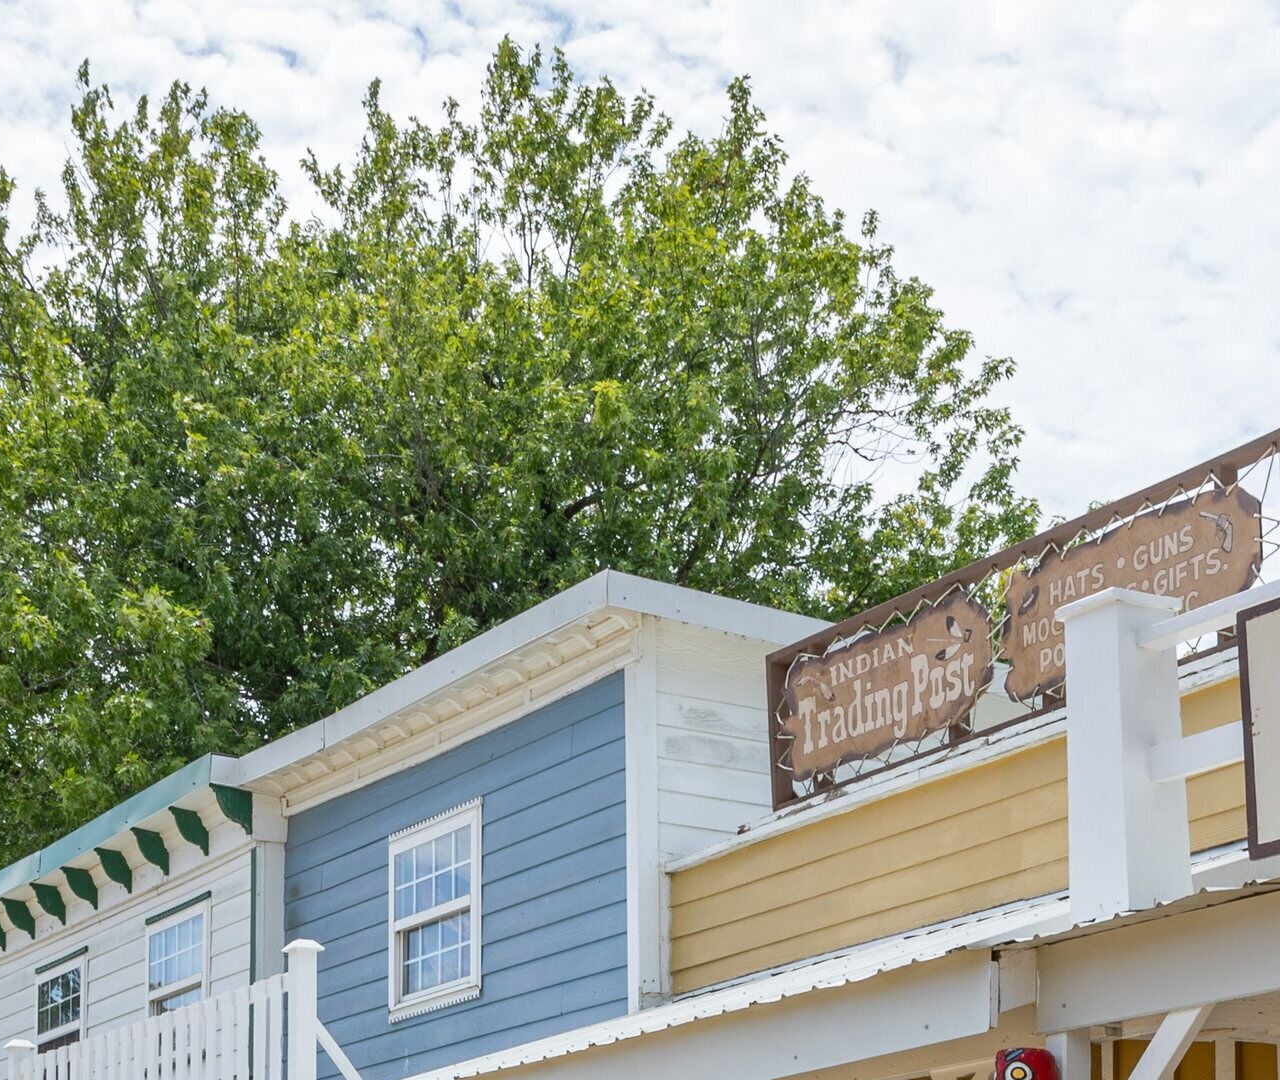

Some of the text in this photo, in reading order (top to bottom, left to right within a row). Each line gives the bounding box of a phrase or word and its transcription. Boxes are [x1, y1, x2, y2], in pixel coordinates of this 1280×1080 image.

[1049, 525, 1194, 606] HATS GUNS
[829, 633, 914, 687] INDIAN
[798, 652, 976, 755] Trading Post
